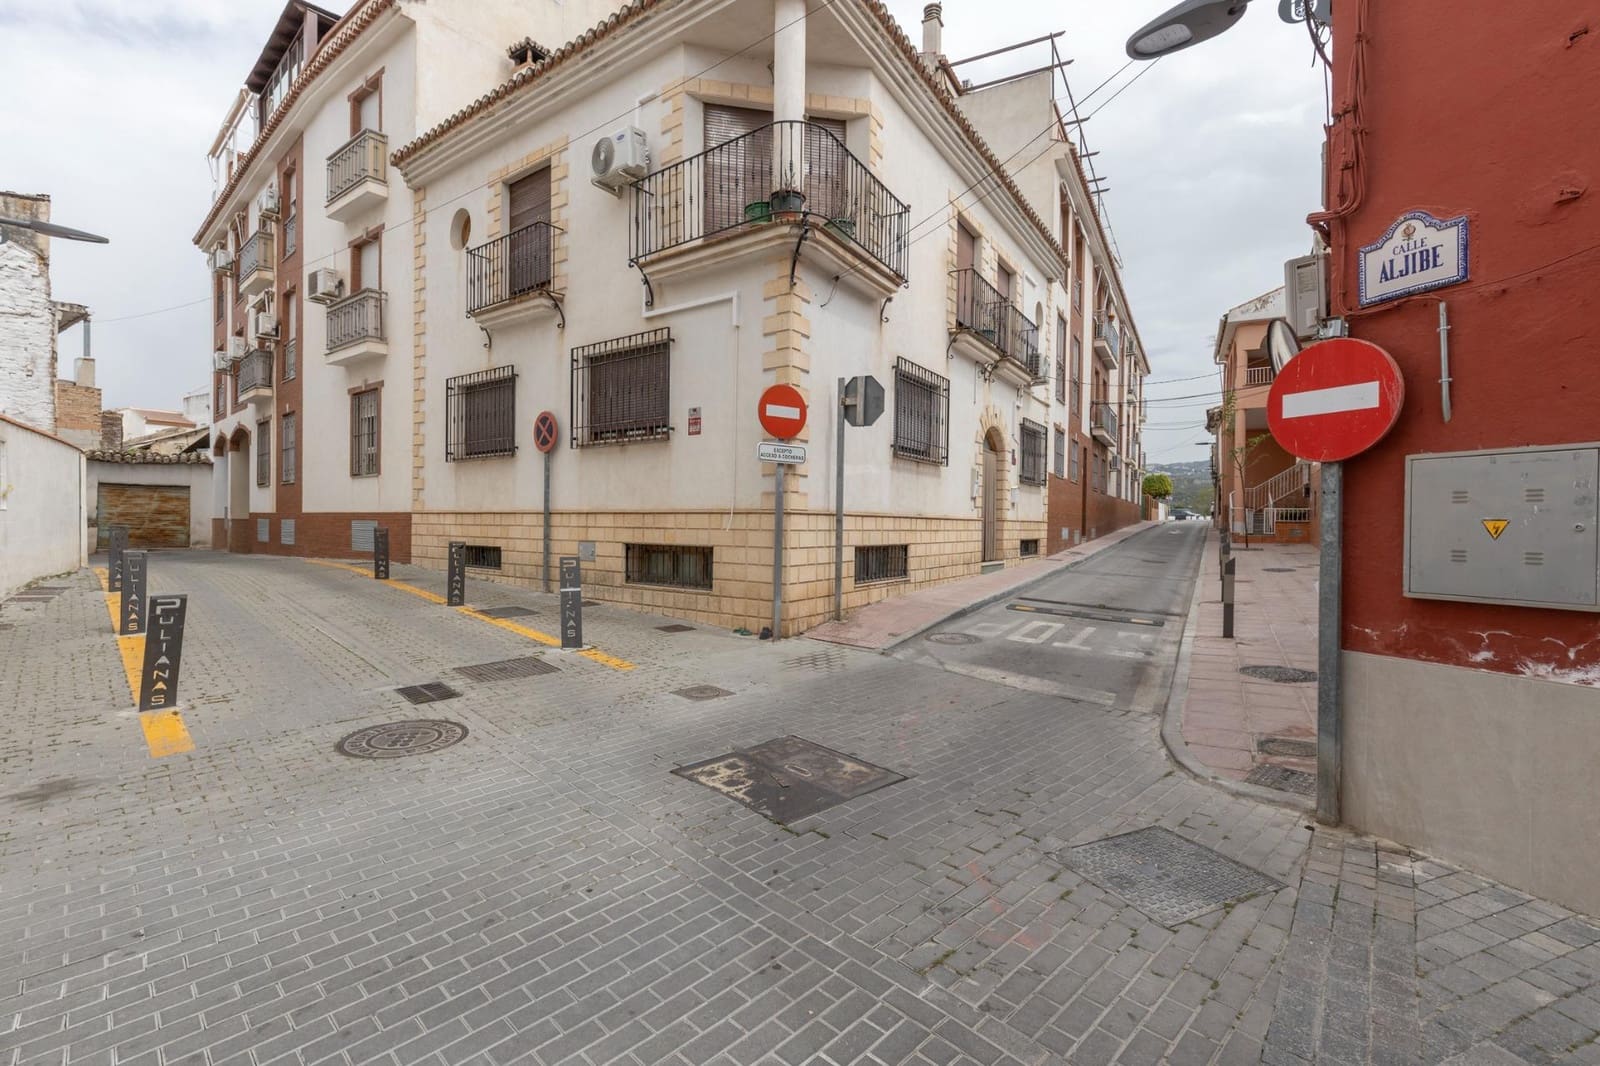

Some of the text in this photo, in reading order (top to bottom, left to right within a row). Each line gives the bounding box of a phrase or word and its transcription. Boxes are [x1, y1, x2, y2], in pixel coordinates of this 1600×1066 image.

[1379, 244, 1444, 283] ALJIBE
[1393, 237, 1428, 255] CALLE
[127, 551, 143, 631] PULIANAS
[151, 598, 180, 705] PULIANAS
